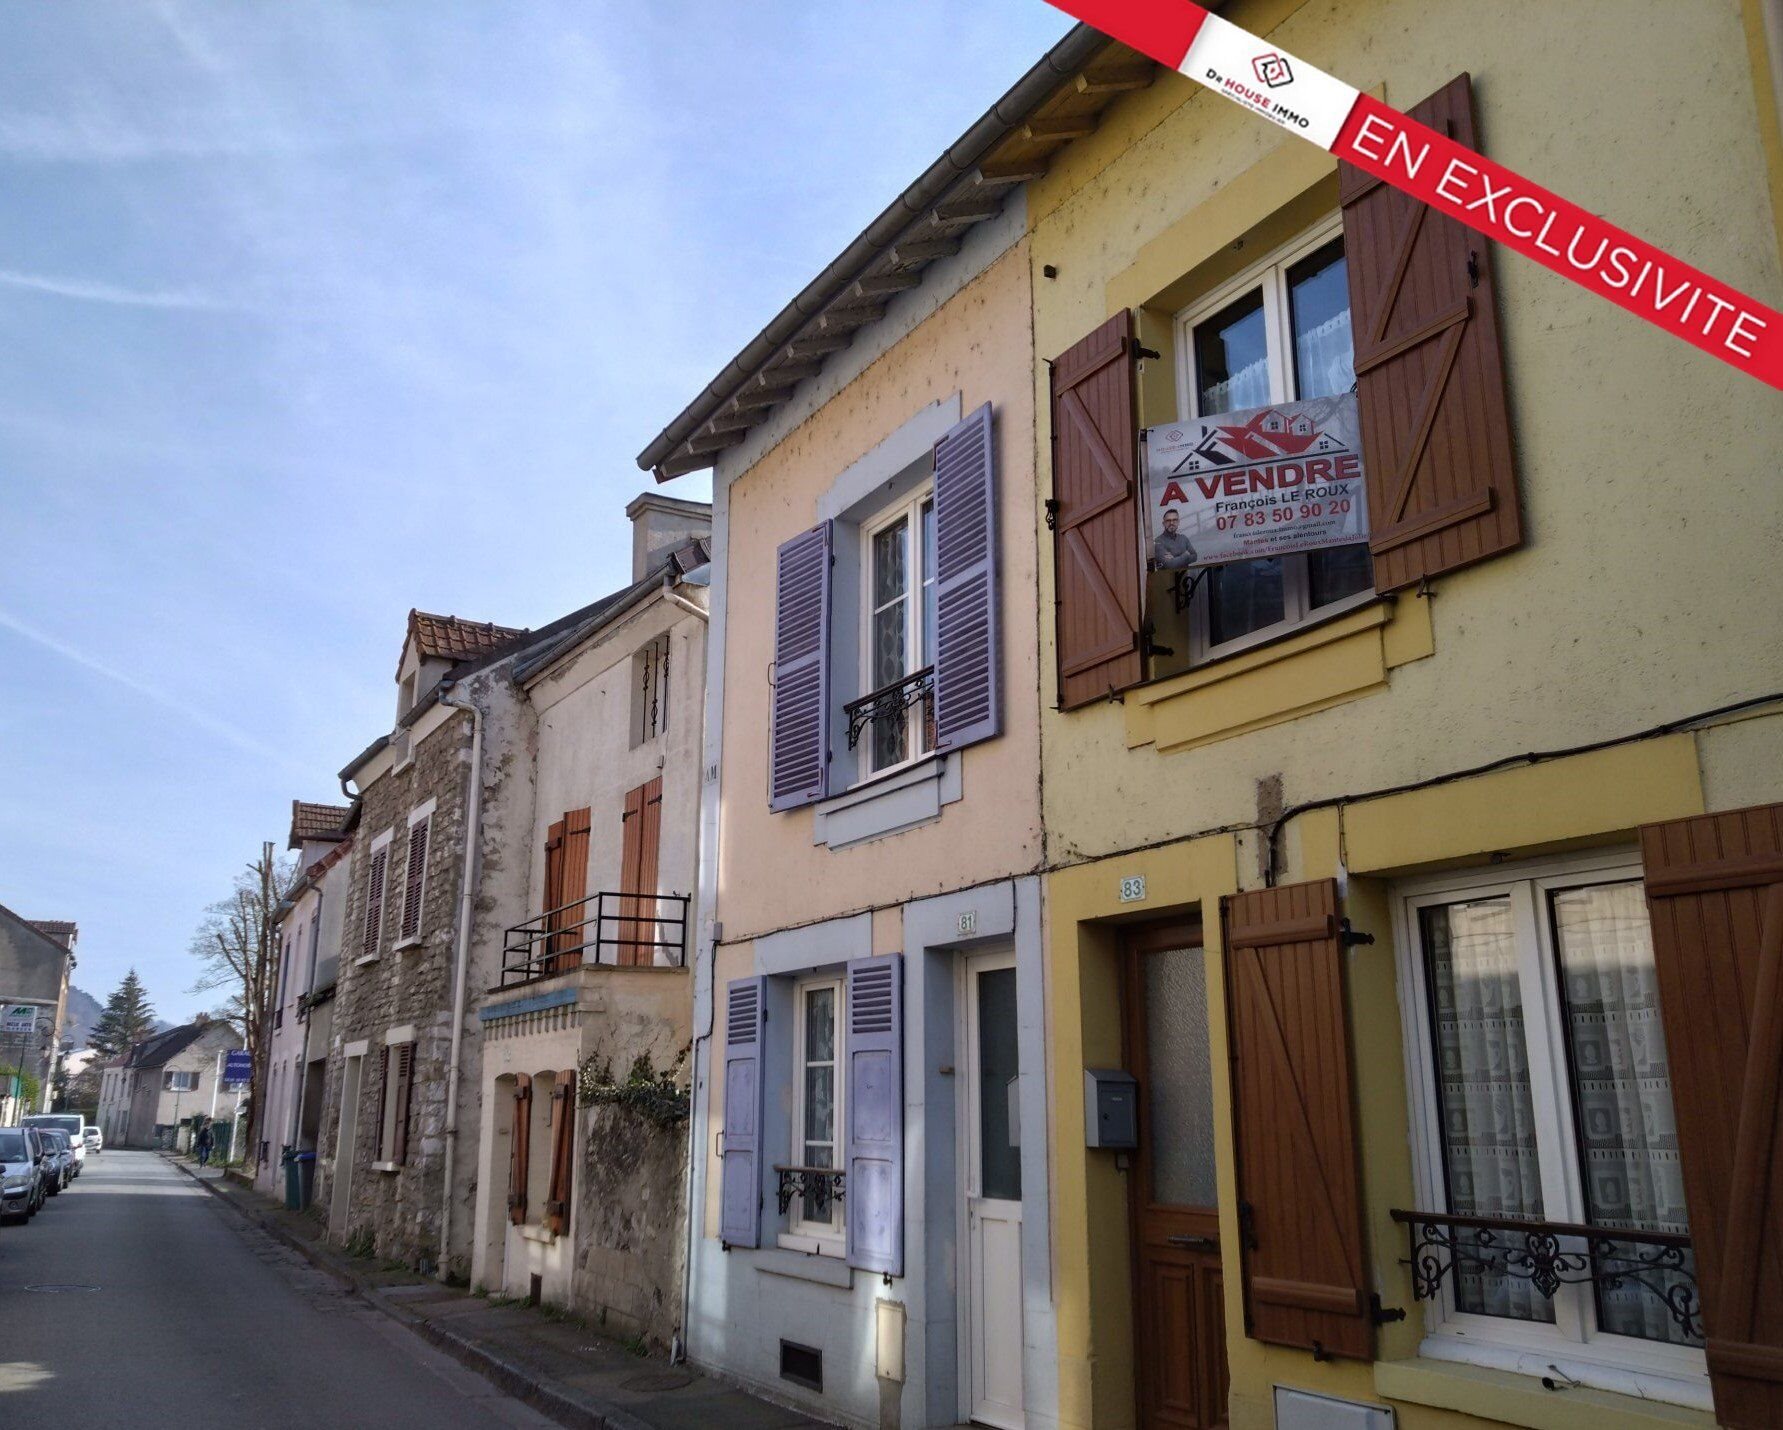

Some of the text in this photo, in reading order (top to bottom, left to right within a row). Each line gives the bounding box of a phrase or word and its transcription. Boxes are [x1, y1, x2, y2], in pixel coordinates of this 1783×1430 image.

[1160, 454, 1361, 506] A VENDRE
[1215, 484, 1349, 513] François LE ROUX
[1216, 499, 1350, 531] 07 83 50 90 20
[1293, 529, 1327, 540] alentours
[1123, 880, 1142, 898] 83
[961, 916, 973, 930] 81
